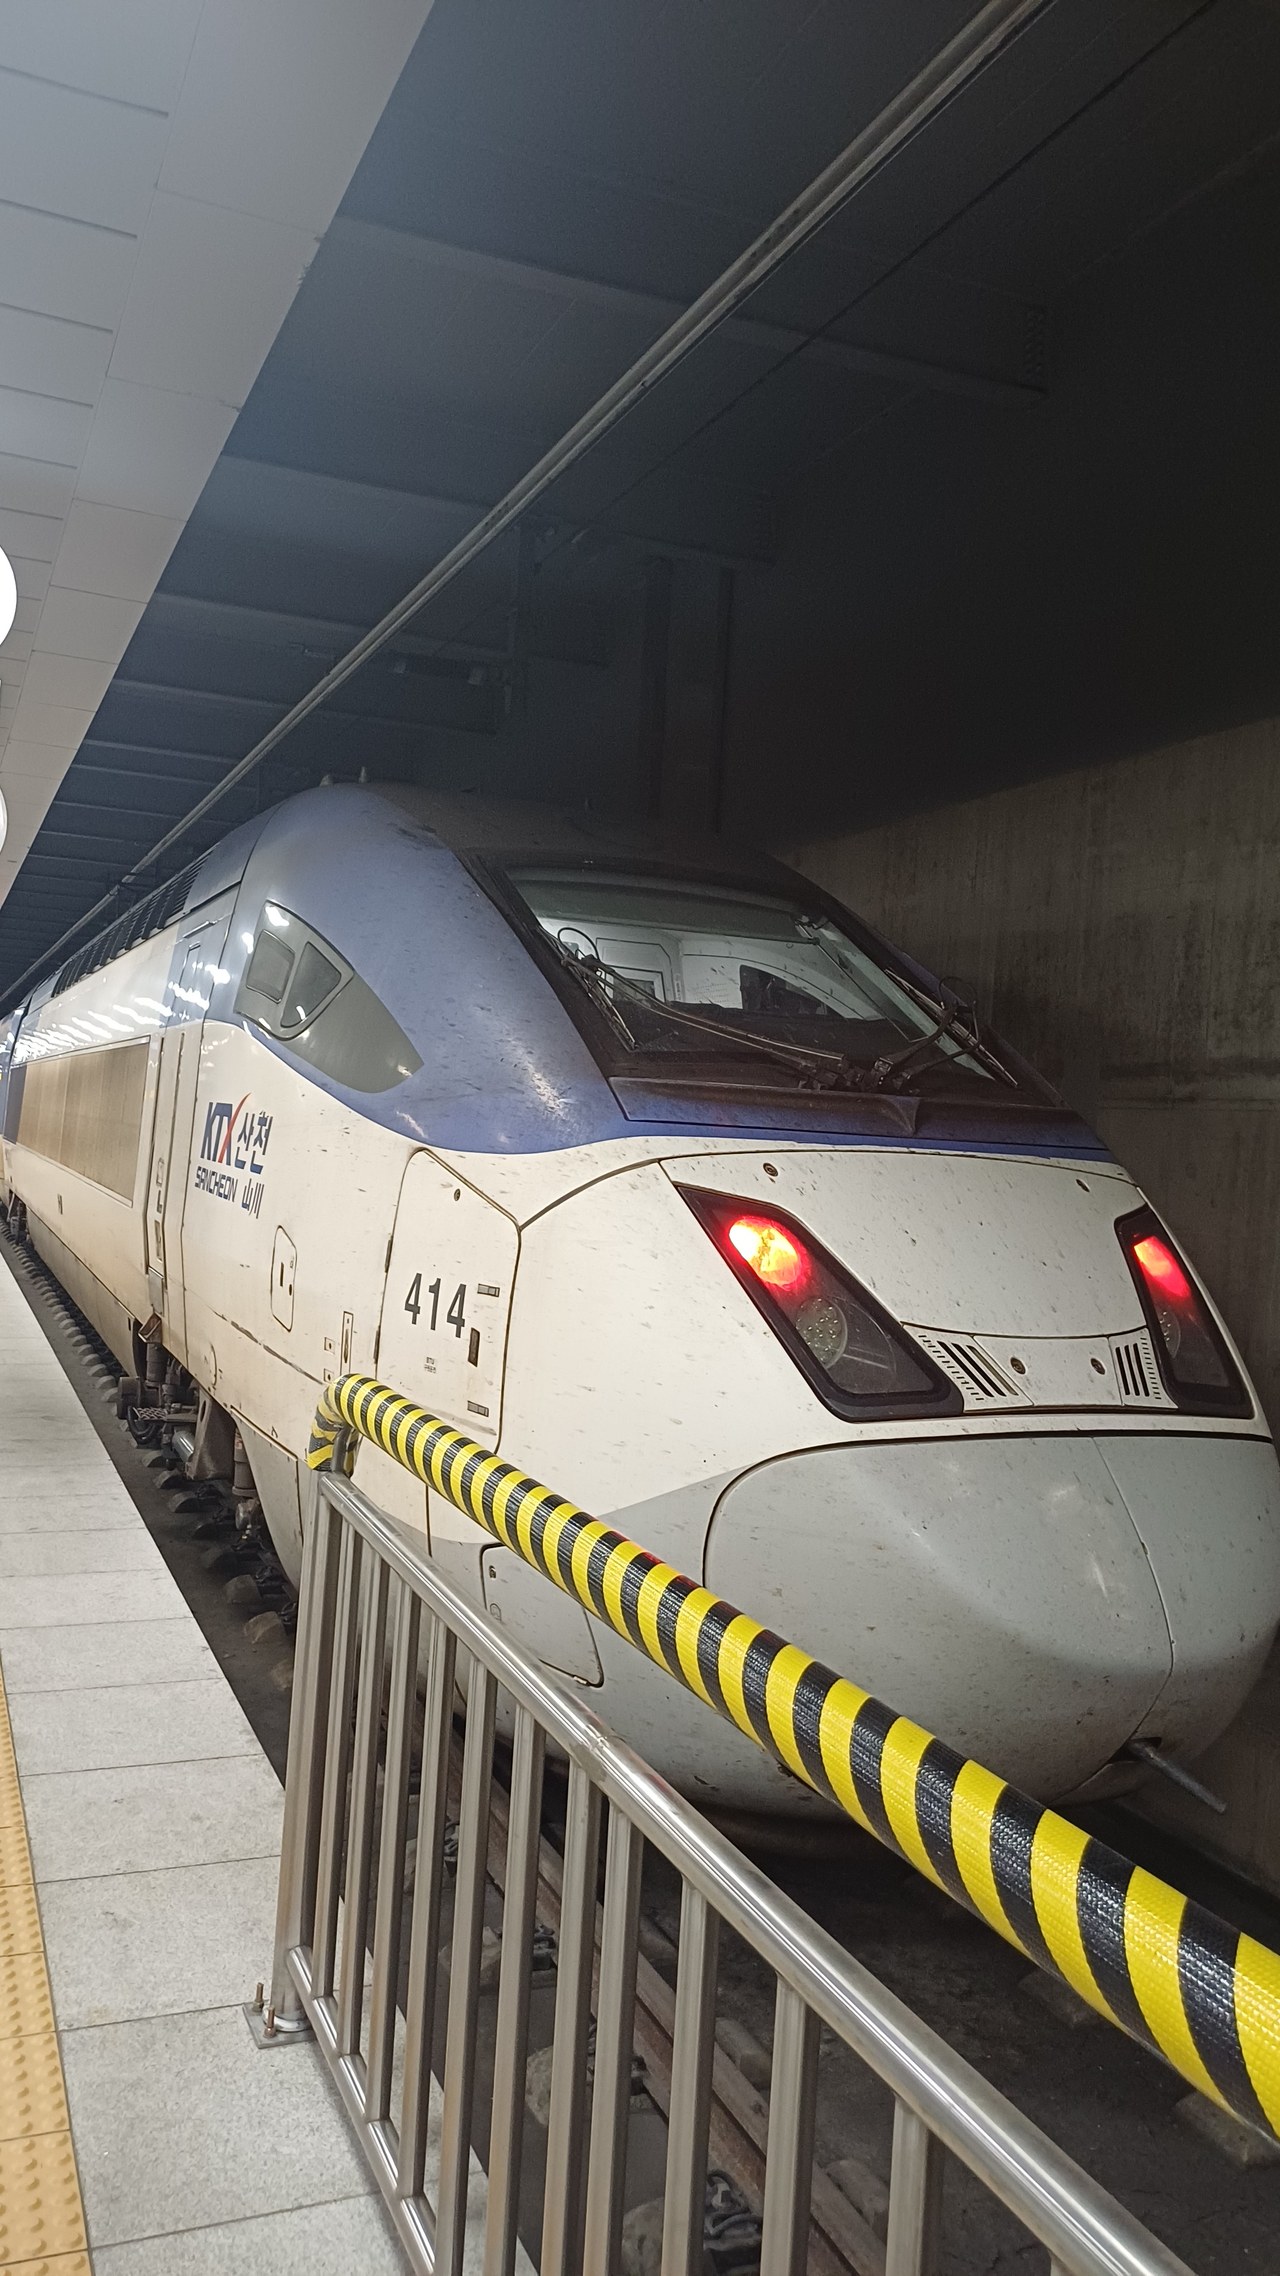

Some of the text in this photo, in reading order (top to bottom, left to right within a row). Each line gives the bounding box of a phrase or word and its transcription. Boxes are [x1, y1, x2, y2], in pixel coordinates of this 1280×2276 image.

[200, 1092, 273, 1175] KTX 산천
[194, 1166, 265, 1220] SANCHEON 山川
[404, 1272, 467, 1339] 414
